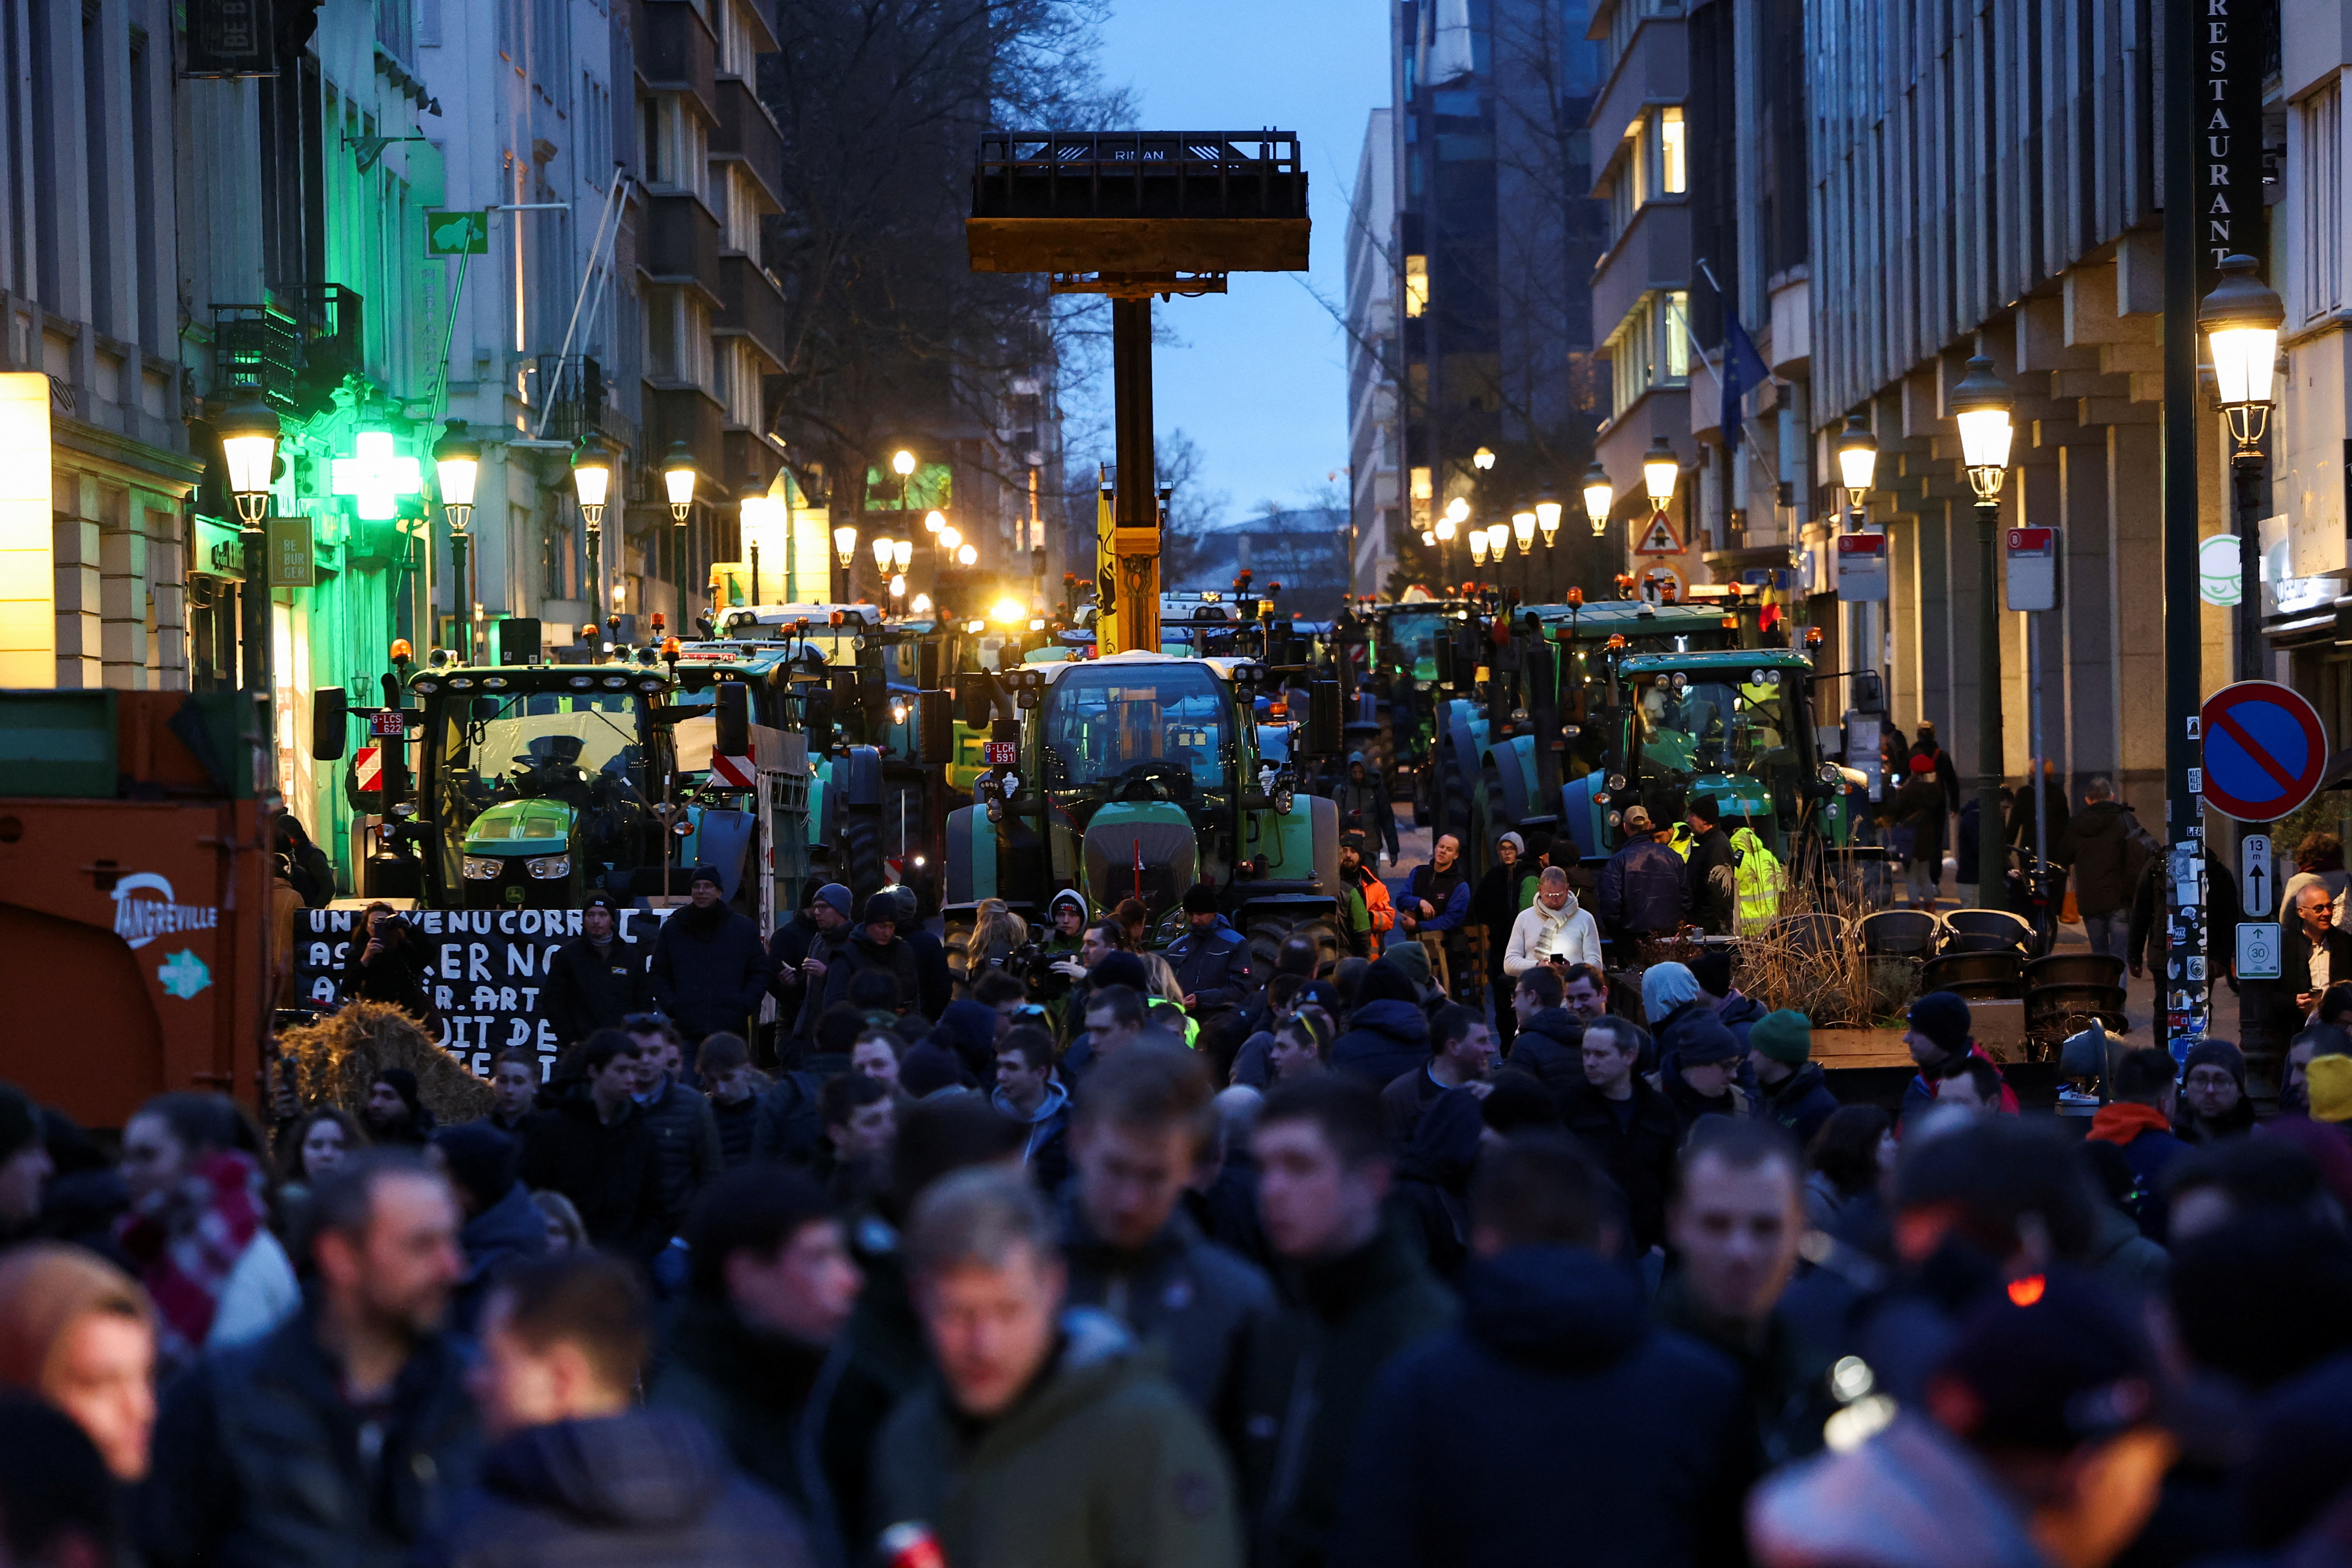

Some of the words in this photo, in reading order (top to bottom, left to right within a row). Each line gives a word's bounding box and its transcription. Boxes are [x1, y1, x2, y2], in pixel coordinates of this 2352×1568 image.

[2207, 0, 2230, 270] RESTAURANT
[284, 539, 296, 551] BE
[284, 553, 304, 565] BUR
[285, 567, 305, 579] GER
[372, 715, 401, 724] G-LCS
[384, 724, 401, 733] 622
[985, 744, 1014, 753] G-LCH
[997, 753, 1013, 762] 591
[2188, 827, 2203, 836] LEA
[2250, 840, 2263, 851] 13
[309, 910, 352, 933] UN
[498, 908, 677, 944] CORRCT
[2251, 949, 2265, 958] 30
[505, 1017, 559, 1053] DE
